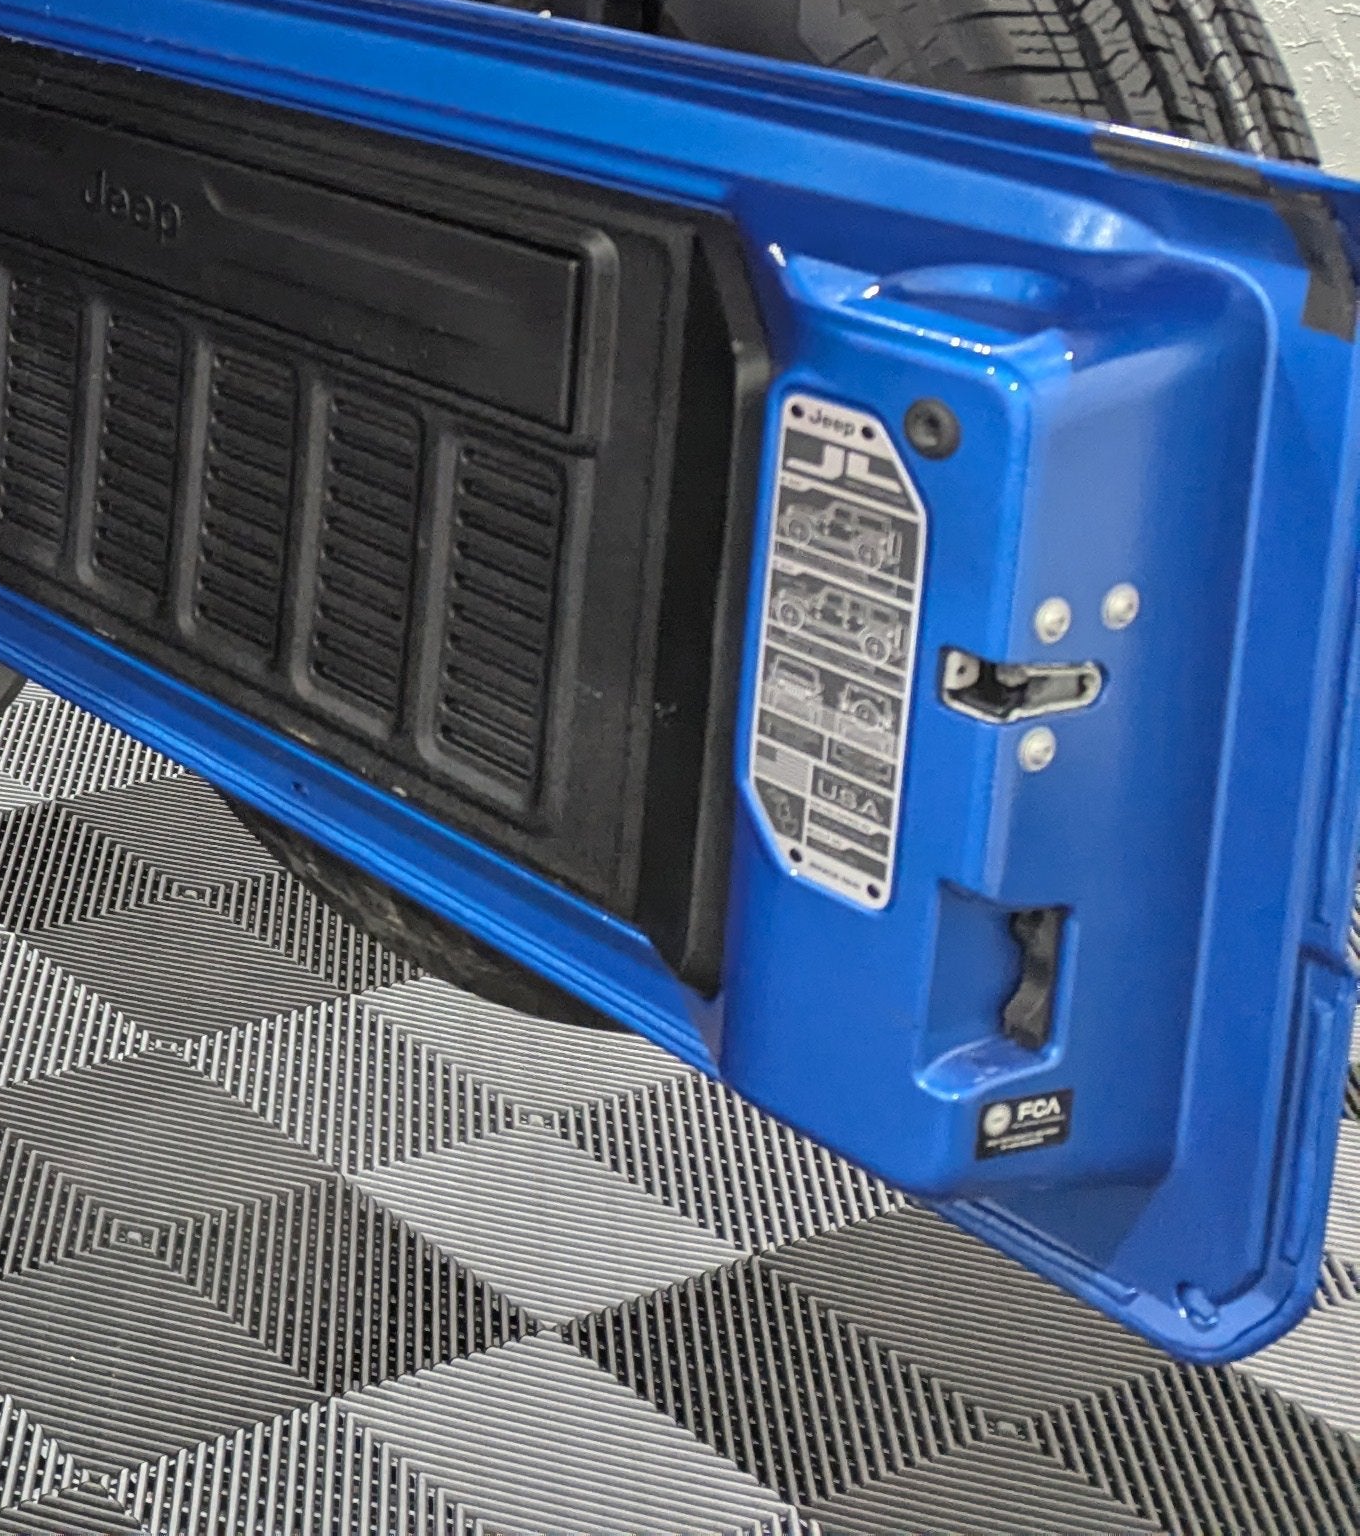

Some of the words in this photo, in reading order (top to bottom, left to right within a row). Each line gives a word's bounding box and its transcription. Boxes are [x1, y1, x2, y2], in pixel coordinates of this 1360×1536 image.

[807, 408, 857, 438] Jeep
[785, 443, 903, 495] JL
[815, 776, 883, 825] USA
[1017, 1096, 1061, 1122] FCA
